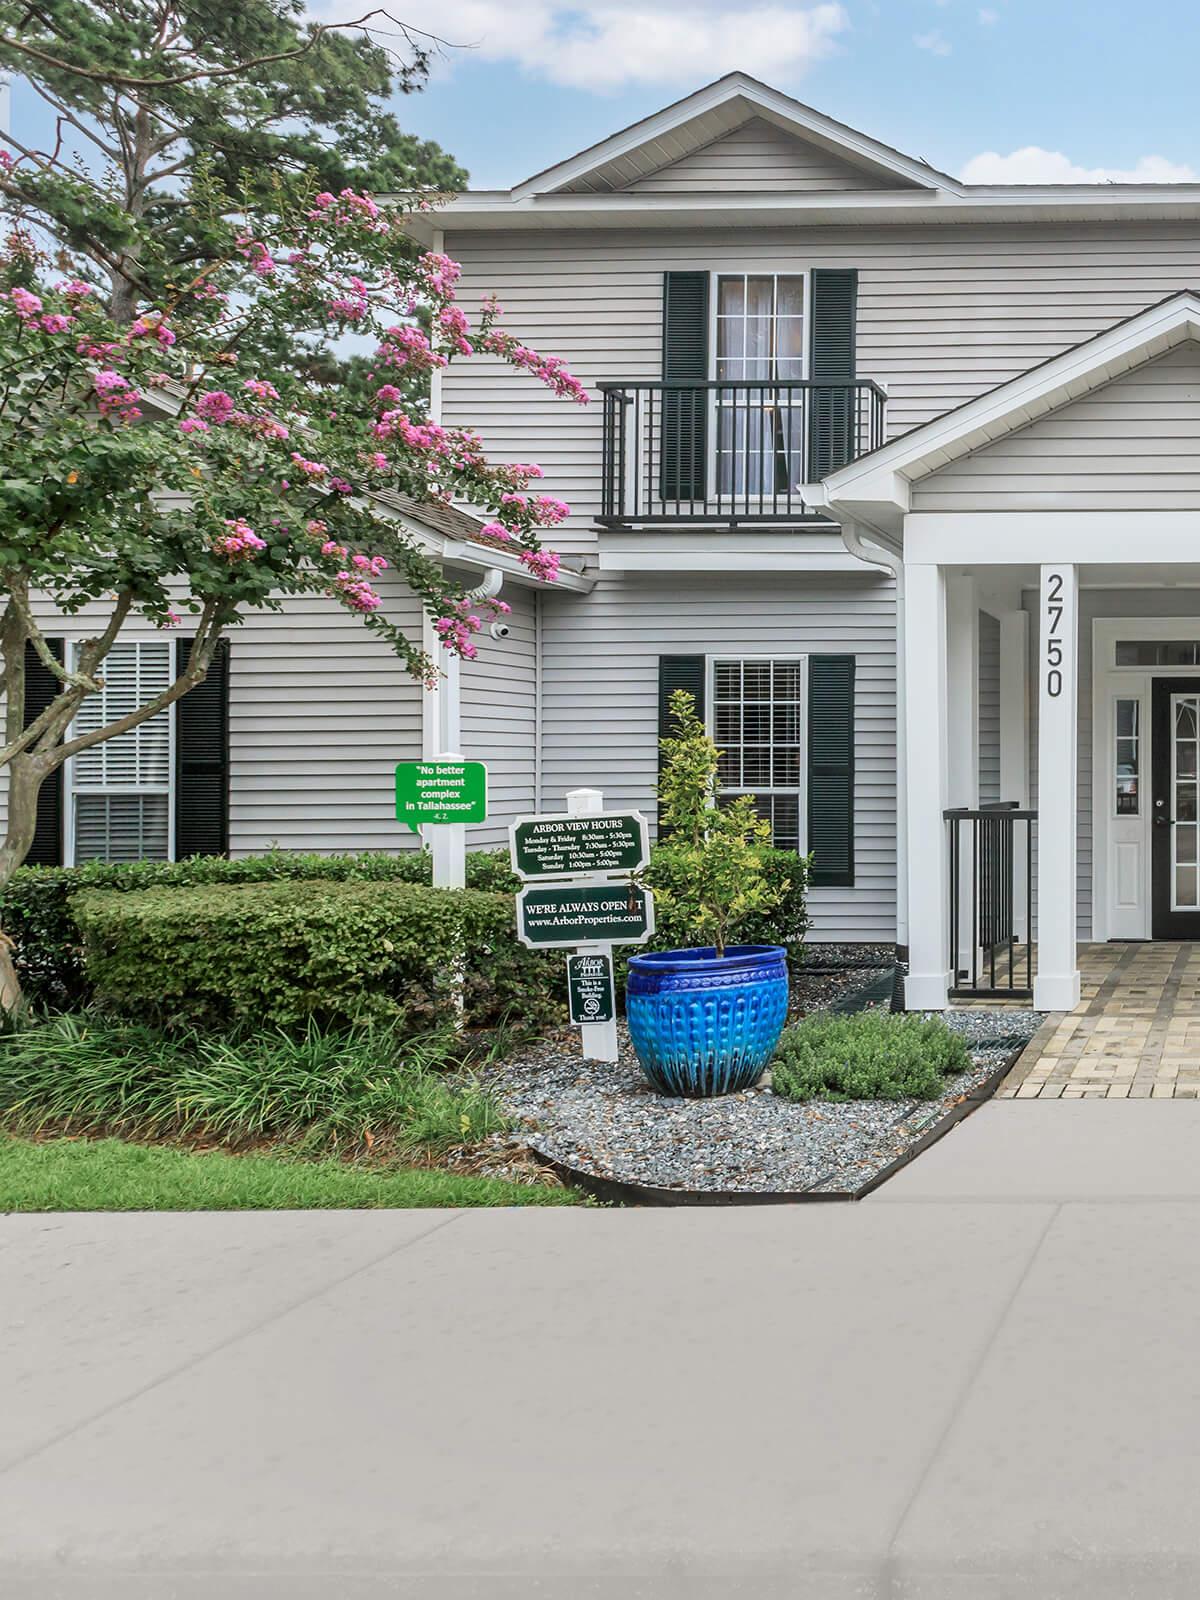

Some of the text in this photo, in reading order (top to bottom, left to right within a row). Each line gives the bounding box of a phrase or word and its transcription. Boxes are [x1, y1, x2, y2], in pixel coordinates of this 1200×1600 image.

[1047, 574, 1063, 697] 2750
[416, 766, 465, 774] "No better
[416, 778, 465, 788] apartment
[420, 790, 460, 800] complex
[406, 801, 476, 810] in Tallahassee"
[533, 820, 623, 834] ARBOR VIEW HOURS
[524, 836, 549, 845] Monday
[558, 835, 576, 843] Friday
[523, 846, 548, 854] Tuesday
[552, 844, 580, 852] Thursday
[537, 852, 564, 861] Saturday
[542, 862, 564, 870] Sunday
[526, 904, 558, 914] WE'RE
[559, 902, 600, 912] ALWAYS
[600, 900, 628, 910] OPEN
[528, 914, 642, 926] www.ArborProperties.com
